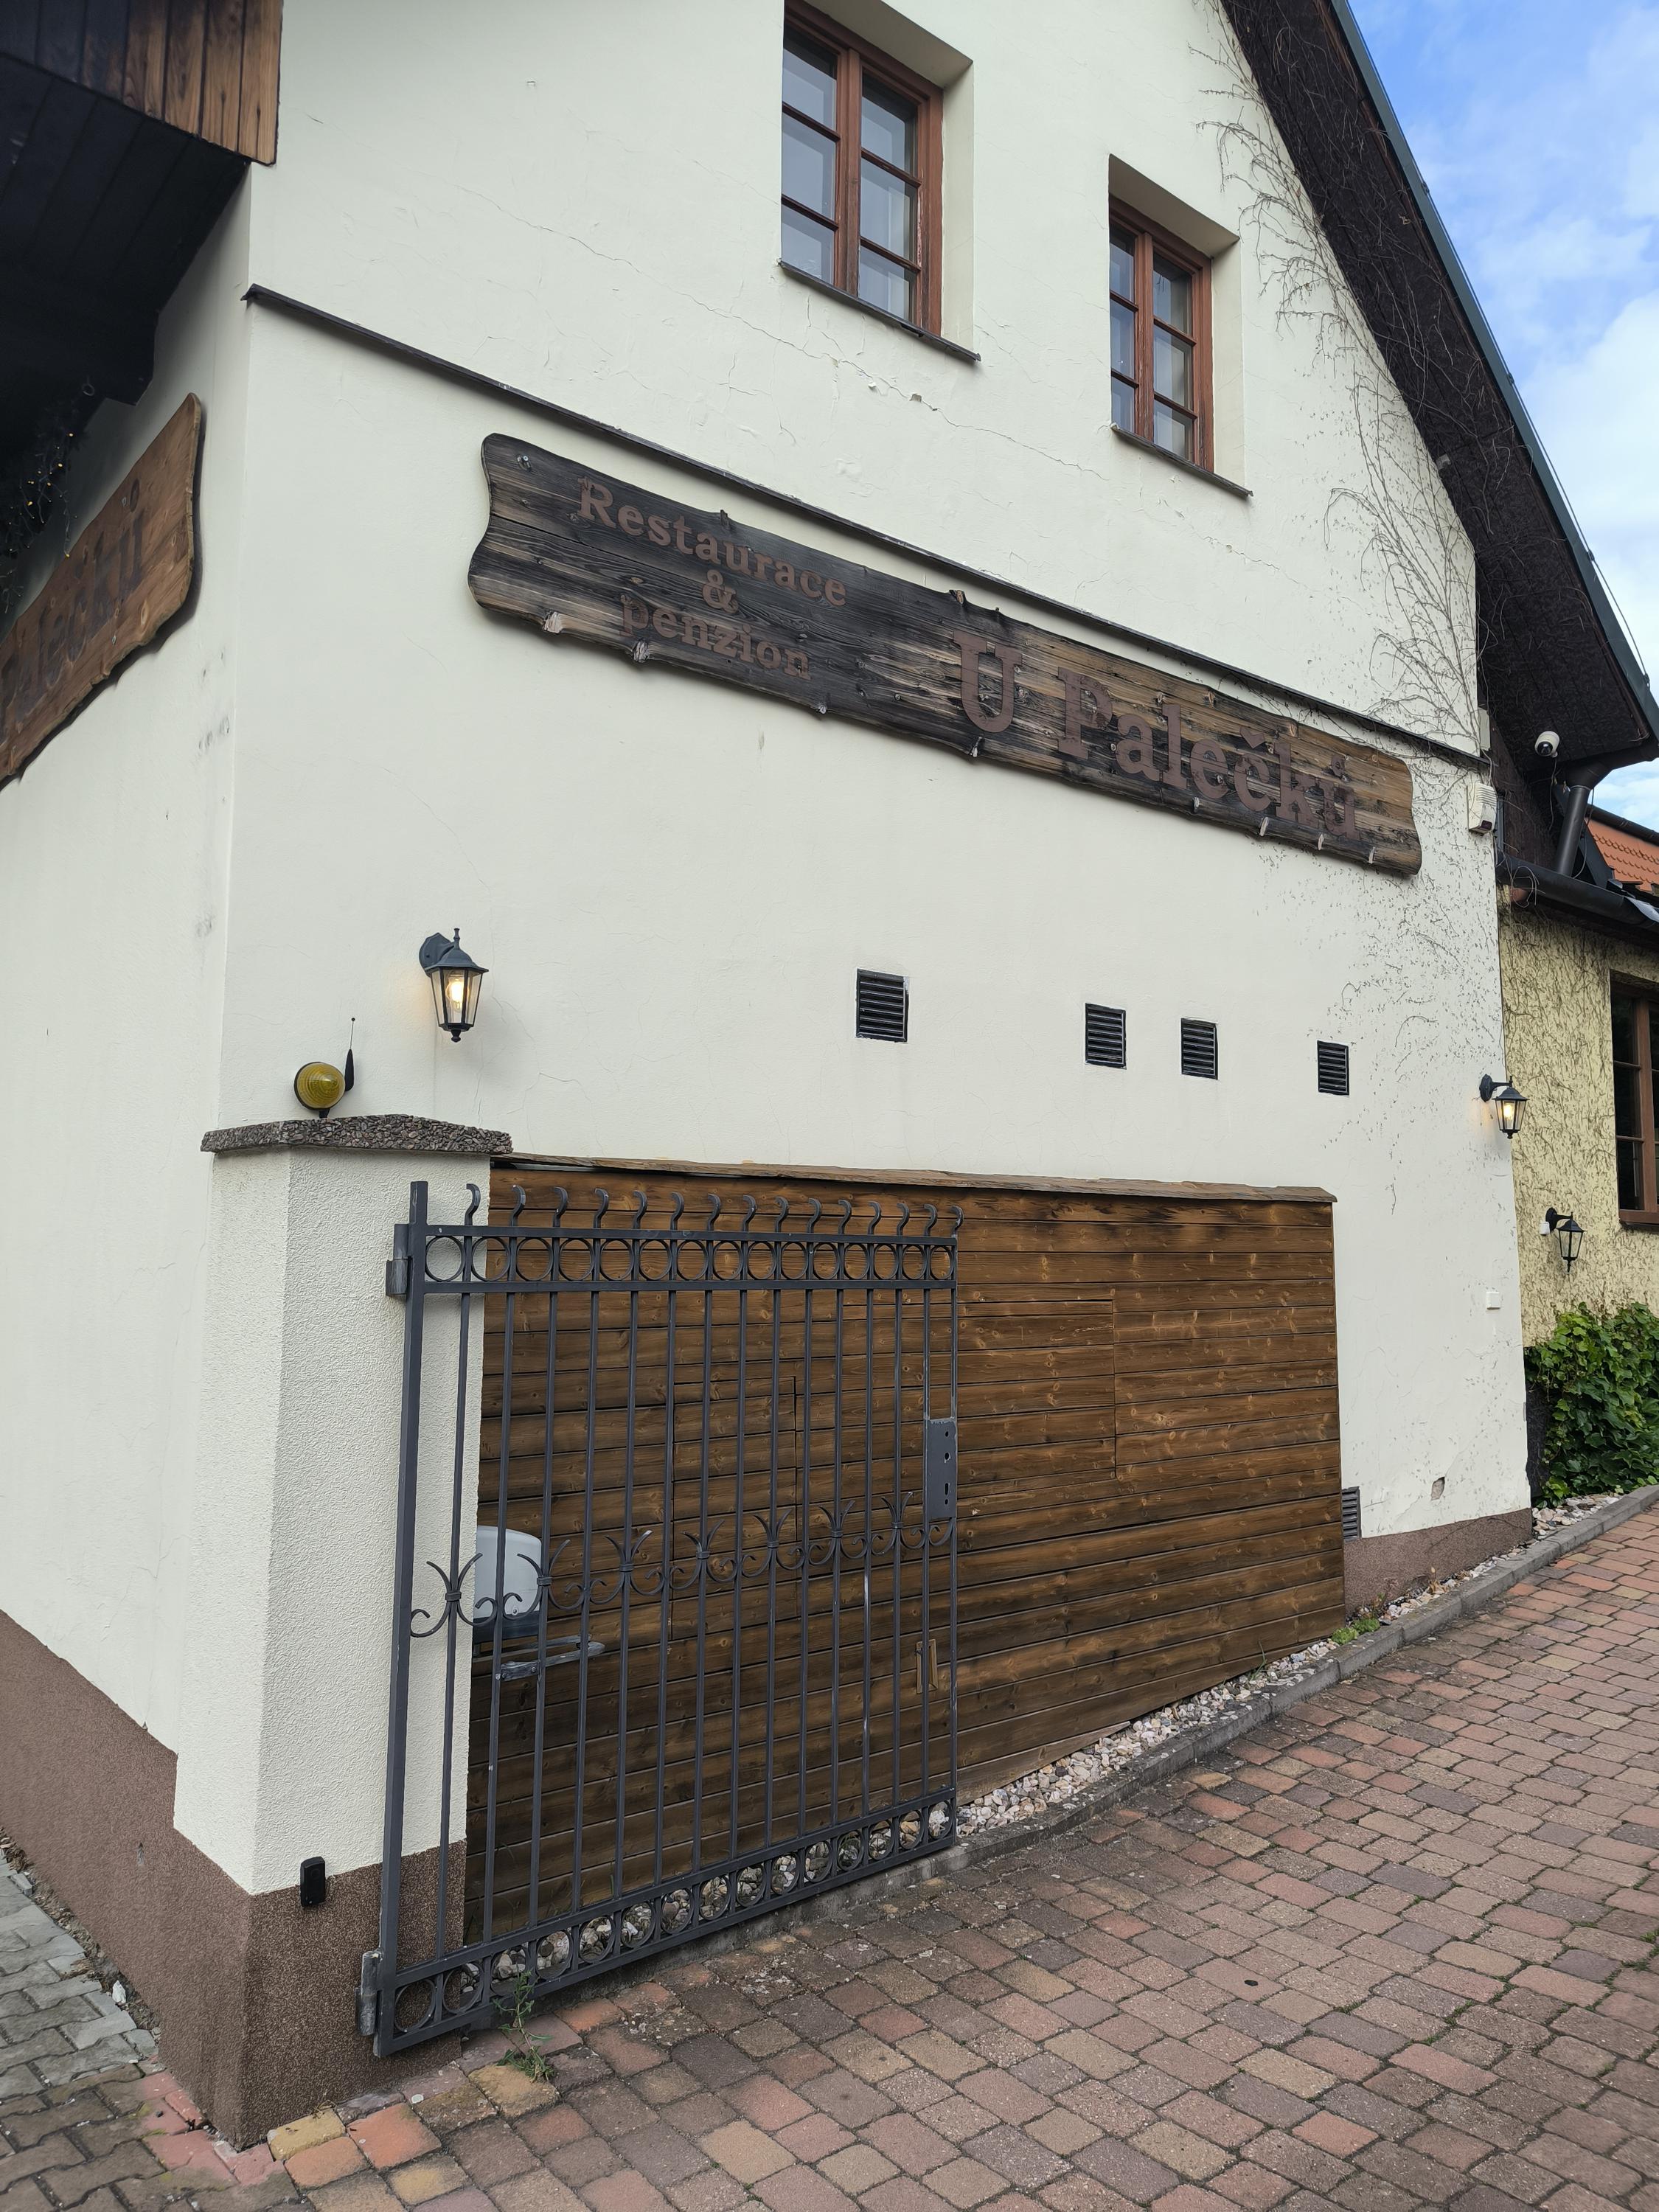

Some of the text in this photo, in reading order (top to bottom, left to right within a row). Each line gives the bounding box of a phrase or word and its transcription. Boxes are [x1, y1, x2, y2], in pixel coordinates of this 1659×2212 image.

[577, 476, 846, 607] Restaurace
[702, 569, 738, 613] &
[619, 594, 811, 679] penzion
[952, 628, 1361, 840] U Palečků
